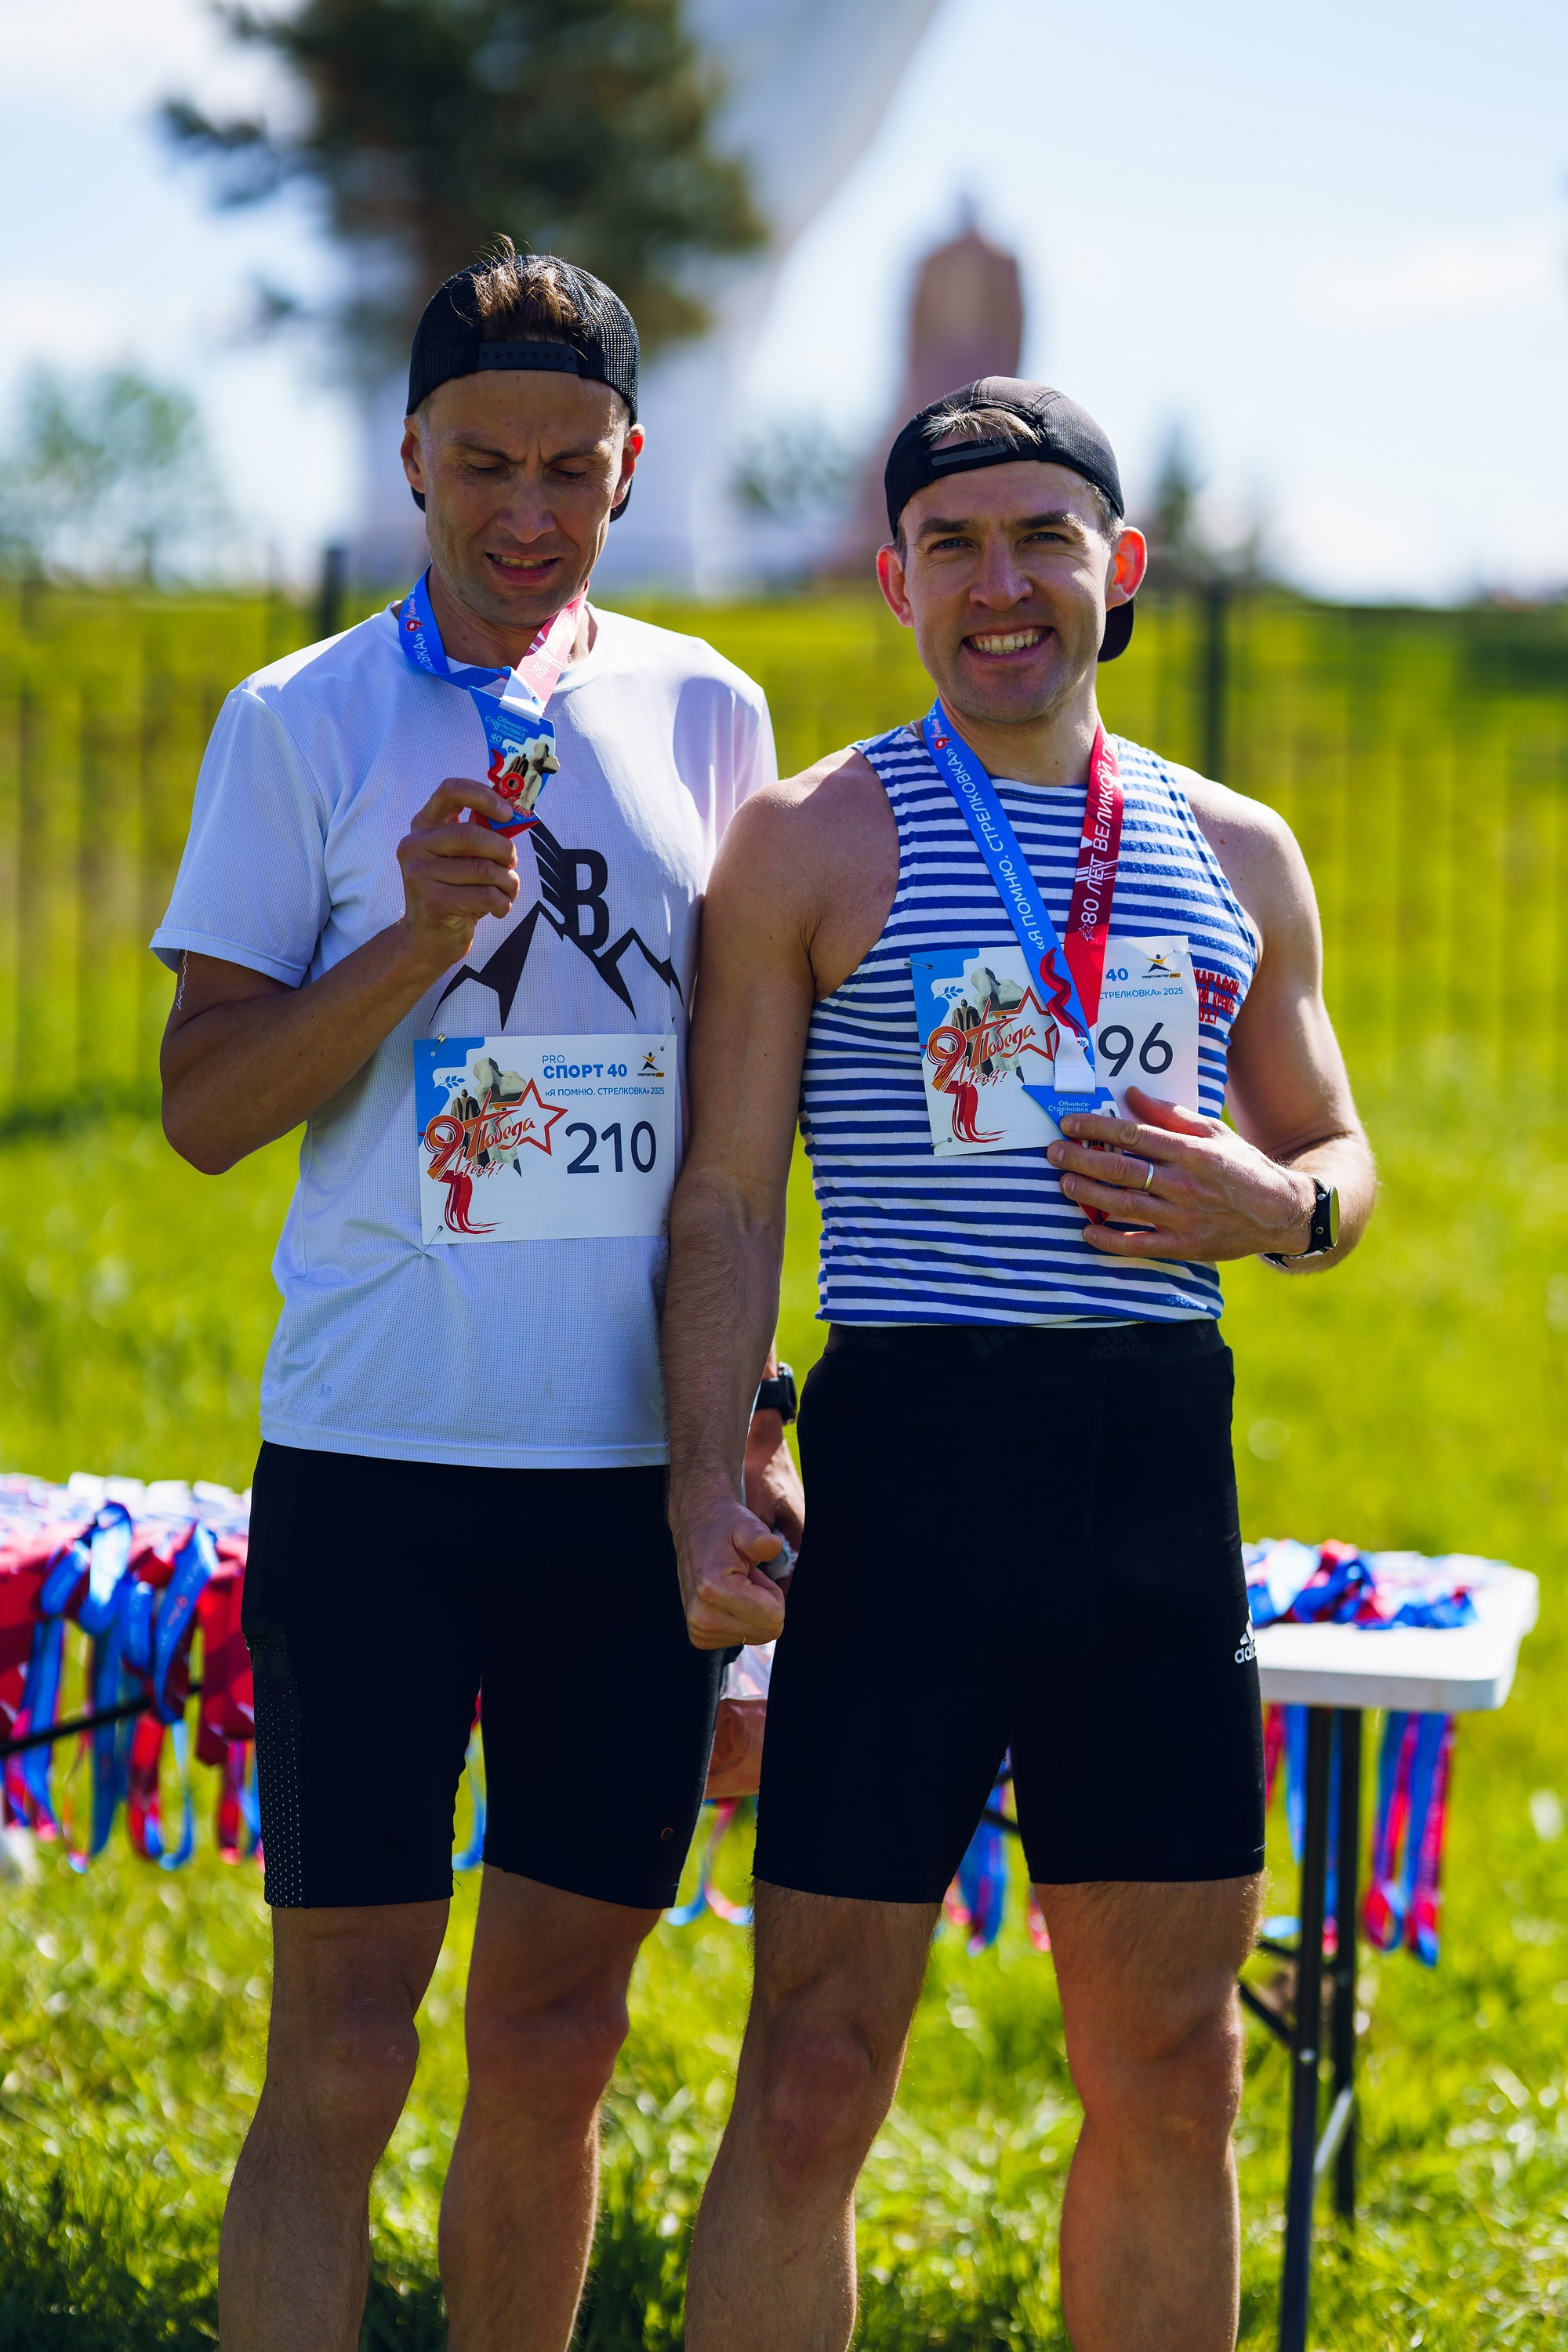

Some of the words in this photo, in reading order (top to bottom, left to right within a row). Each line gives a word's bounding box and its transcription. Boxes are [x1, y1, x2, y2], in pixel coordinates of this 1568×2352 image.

[405, 619, 423, 632] 9
[498, 715, 528, 733] Обнинск-
[935, 737, 951, 750] 9
[946, 748, 1004, 851] СТРЕЛКОВКА»
[1092, 760, 1114, 852] ВЕЛИКОЙ
[1087, 853, 1105, 895] ЛЕТ
[999, 855, 1037, 927] ПОМНЮ.
[1080, 898, 1099, 924] 80
[1028, 931, 1045, 950] «Я
[1105, 967, 1129, 982] 40
[1099, 989, 1162, 1000] СТРЕЛКОВКА»
[1163, 987, 1184, 996] 2025
[1198, 1006, 1220, 1025] 017
[964, 996, 1037, 1071] Победа
[542, 1054, 565, 1064] PRO
[927, 1025, 967, 1092] 9
[543, 1064, 604, 1079] СПОРТ
[607, 1063, 628, 1078] 40
[557, 1087, 595, 1096] ПОМНЮ.
[597, 1087, 650, 1095] СТРЕЛКОВКА»
[462, 1087, 536, 1162] Победа
[423, 1115, 466, 1181] 9
[564, 1120, 656, 1174] 210
[1089, 1341, 1151, 1359] adidas
